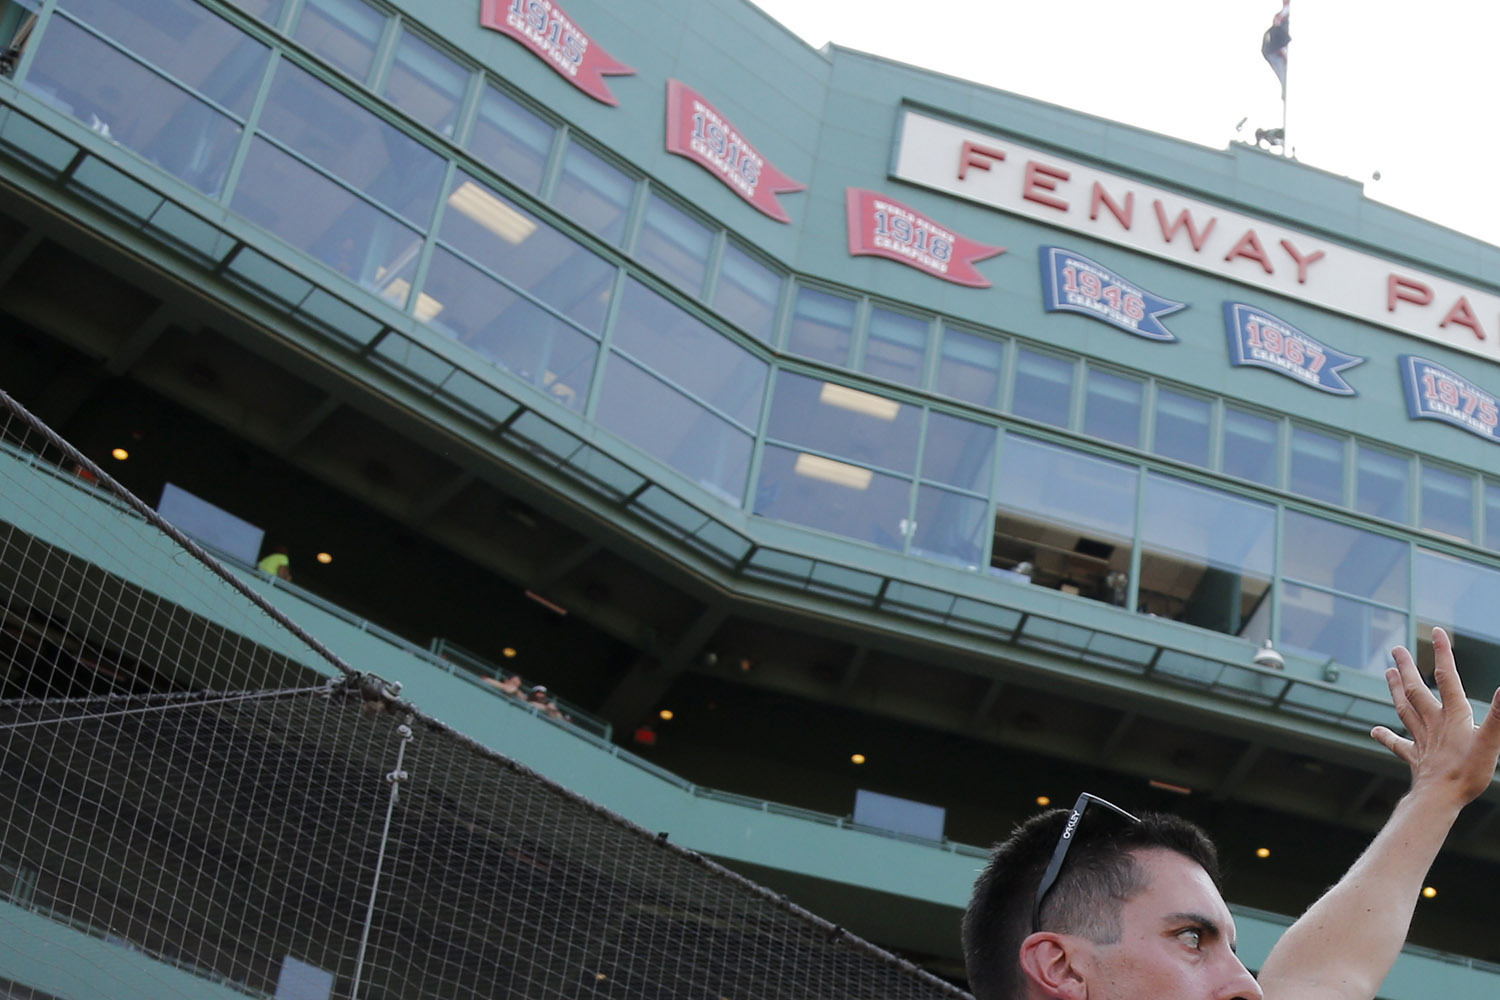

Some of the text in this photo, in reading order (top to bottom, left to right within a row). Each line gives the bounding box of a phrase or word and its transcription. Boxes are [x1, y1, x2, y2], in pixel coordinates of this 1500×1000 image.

[507, 0, 587, 66] 1915
[691, 112, 761, 187] 1916
[874, 210, 953, 263] 1918
[957, 140, 1326, 284] FENWAY
[1063, 265, 1146, 321] 1946
[1246, 320, 1327, 374] 1967
[1422, 373, 1500, 428] 1975
